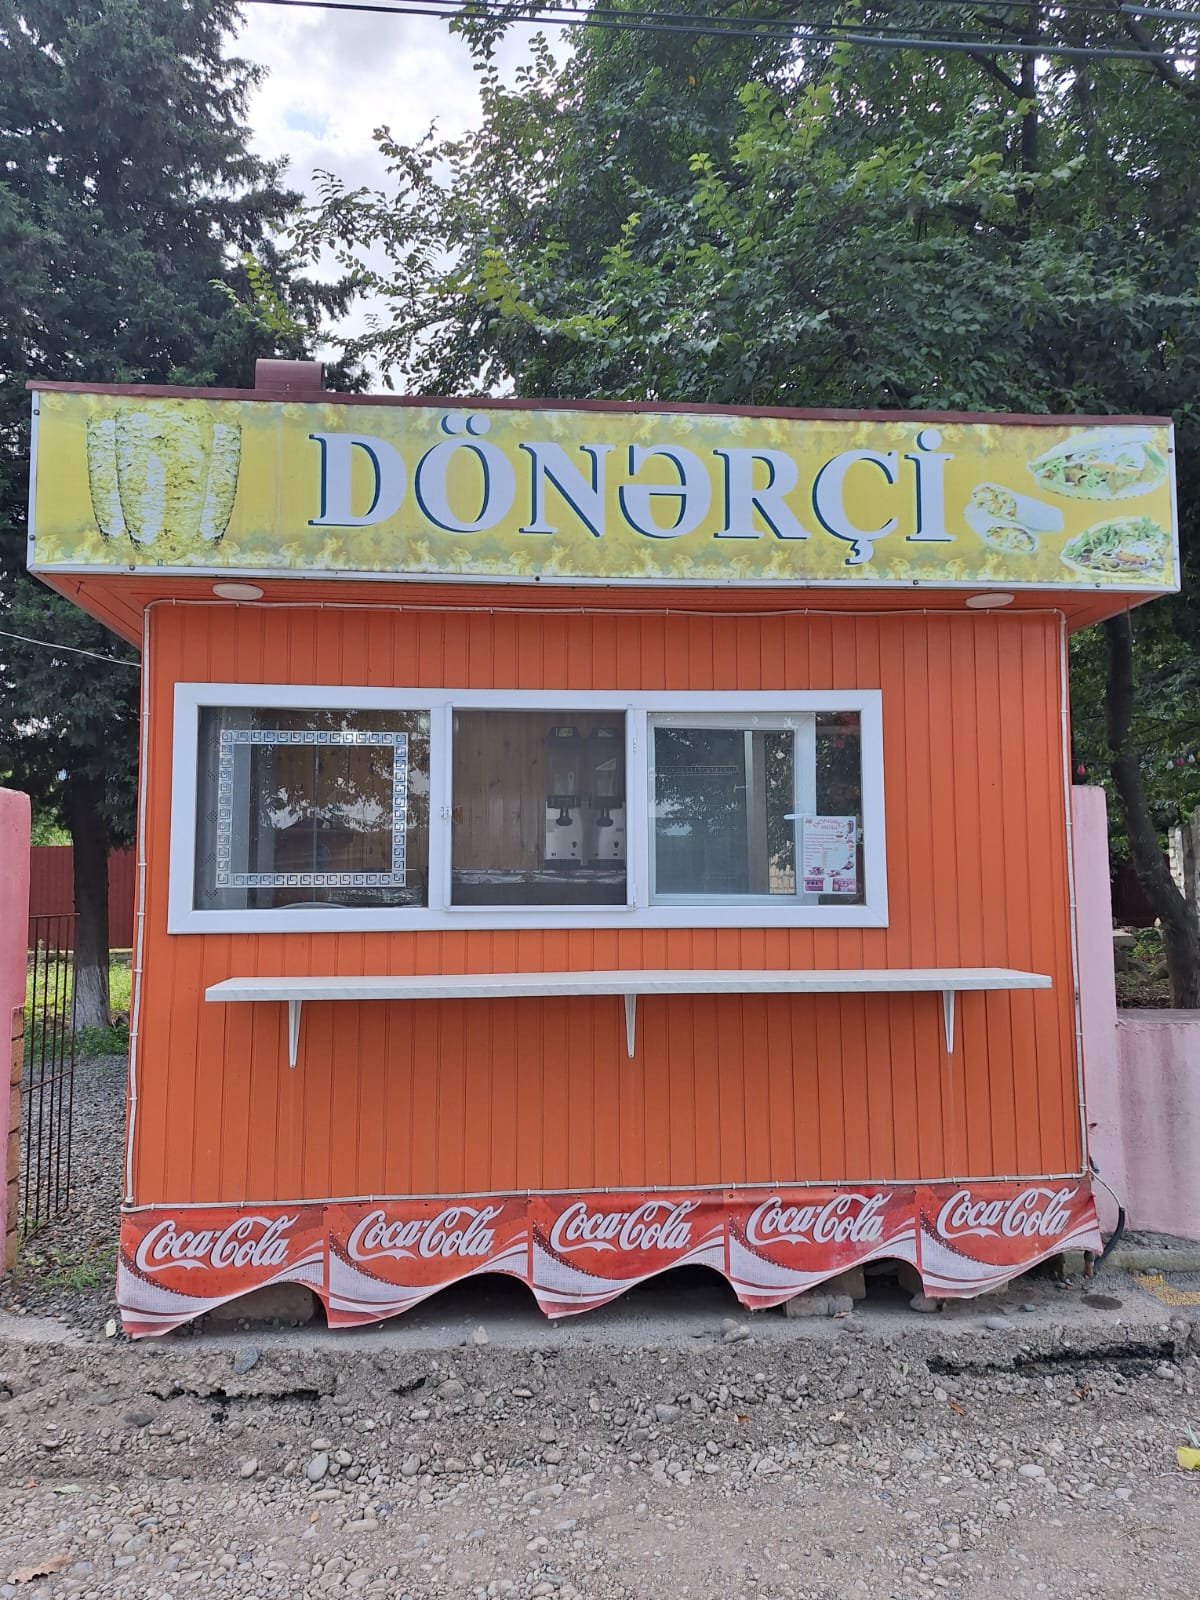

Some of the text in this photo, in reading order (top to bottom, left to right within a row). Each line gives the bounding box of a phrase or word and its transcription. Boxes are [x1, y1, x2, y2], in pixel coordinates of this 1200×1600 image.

[308, 414, 954, 566] DÖNƏRÇİ
[347, 1205, 505, 1263] Coca-Cola
[550, 1200, 702, 1252] Coca-Cola
[746, 1192, 893, 1246] Coca-Cola
[936, 1187, 1079, 1239] Coca-Cola
[135, 1213, 300, 1273] Coca-Cola
